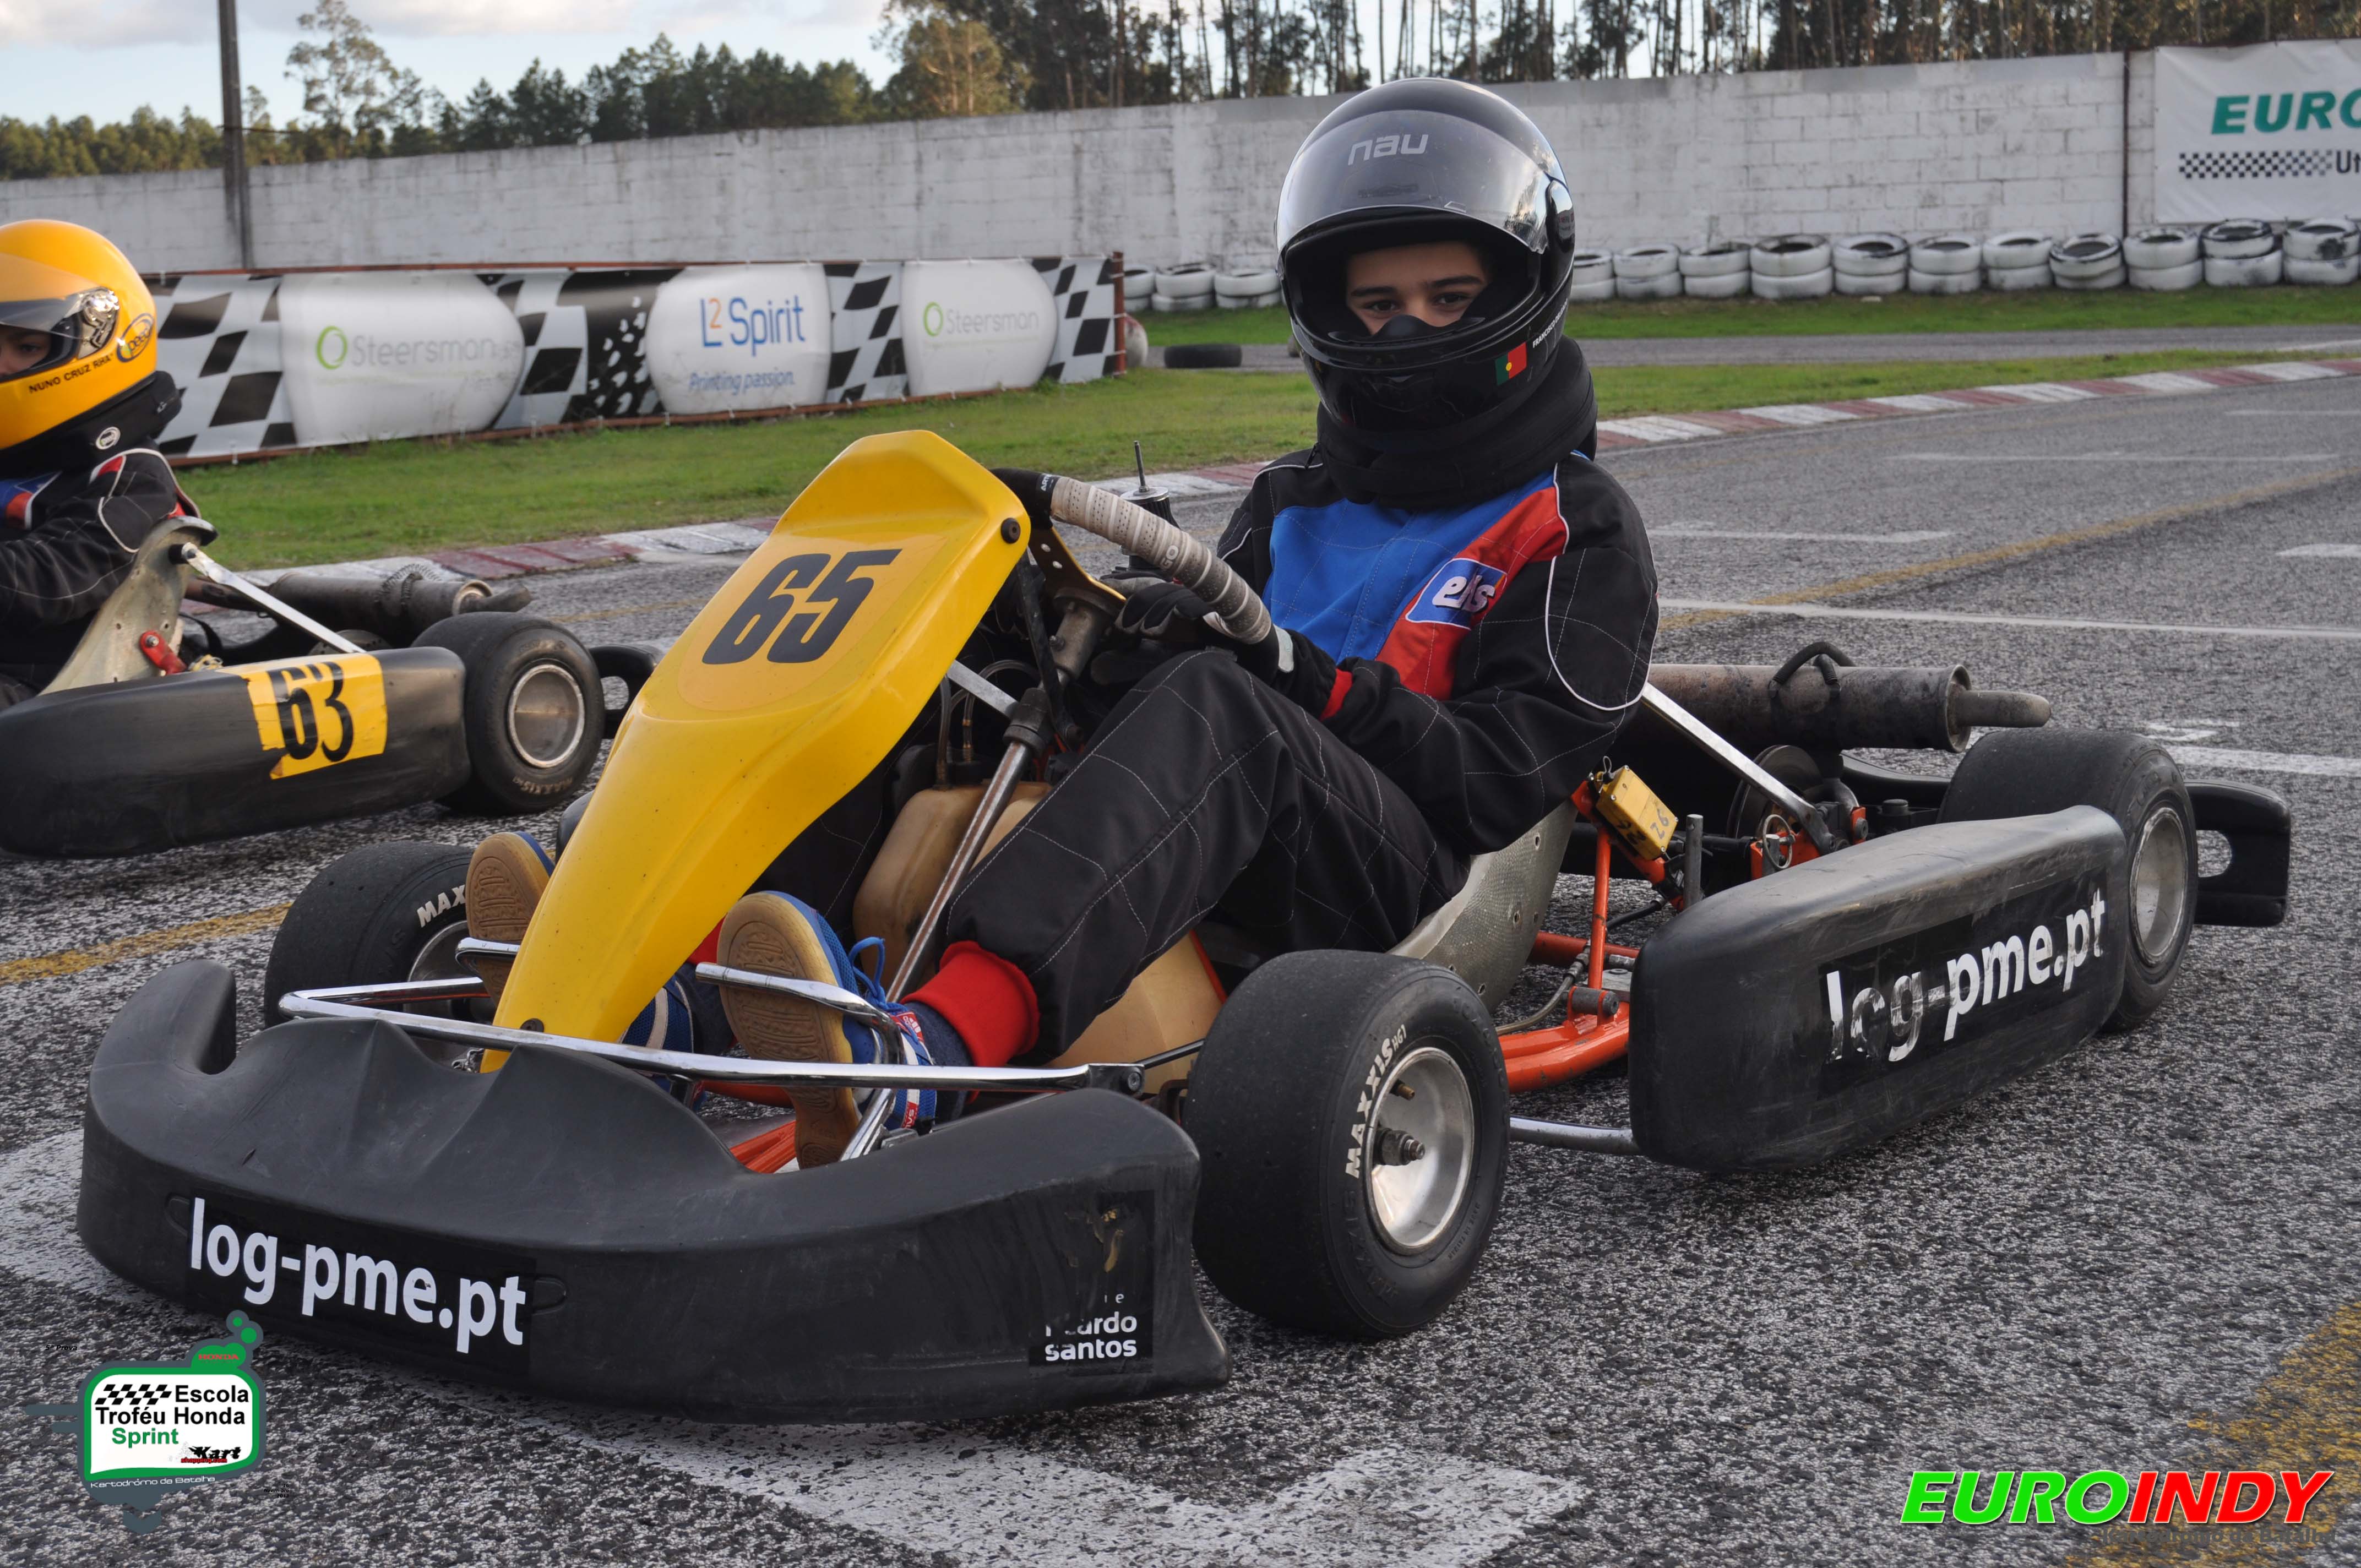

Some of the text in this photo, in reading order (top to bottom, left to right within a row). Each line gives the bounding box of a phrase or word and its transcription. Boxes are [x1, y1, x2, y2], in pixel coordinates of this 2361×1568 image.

[1347, 134, 1429, 166] nau
[728, 295, 807, 358] Spirit
[946, 308, 1040, 335] Steersman
[1532, 319, 1555, 349] FRANCISCO
[351, 334, 496, 368] Steersman
[28, 375, 62, 394] NUNO
[64, 364, 91, 381] CRUZ
[701, 548, 903, 665] 65
[266, 661, 354, 762] 63
[416, 884, 466, 928] MAX
[1345, 1037, 1394, 1179] MAXXIS
[191, 1196, 526, 1354] log-pme.pt
[1045, 1311, 1138, 1337] ardo
[1045, 1339, 1138, 1362] santos
